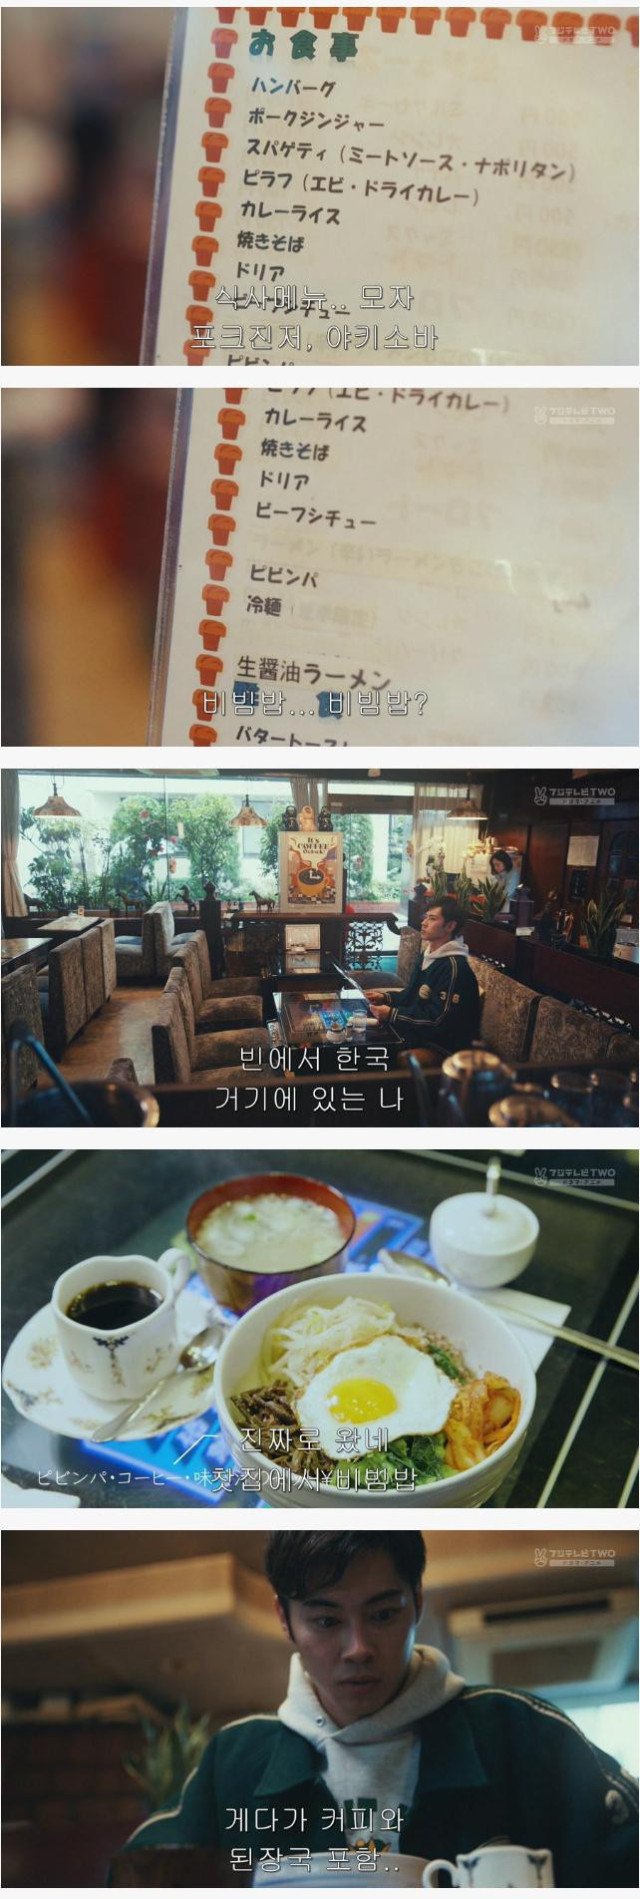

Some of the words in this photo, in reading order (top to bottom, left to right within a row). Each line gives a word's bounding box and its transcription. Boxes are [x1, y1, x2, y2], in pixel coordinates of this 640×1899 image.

[252, 77, 336, 97] ハンバーグ
[249, 107, 384, 131] ポークジンジャー
[241, 200, 340, 225] カレーライス
[237, 231, 305, 253] 焼きそば
[237, 262, 285, 281] ドリア
[265, 407, 367, 433] カレーライス
[261, 438, 330, 461] 焼きそば
[260, 470, 310, 490] ドリア
[256, 502, 376, 529] ビーフシチュー
[250, 564, 319, 588] ピビンパ
[237, 655, 391, 691] 生醤油ラーメン
